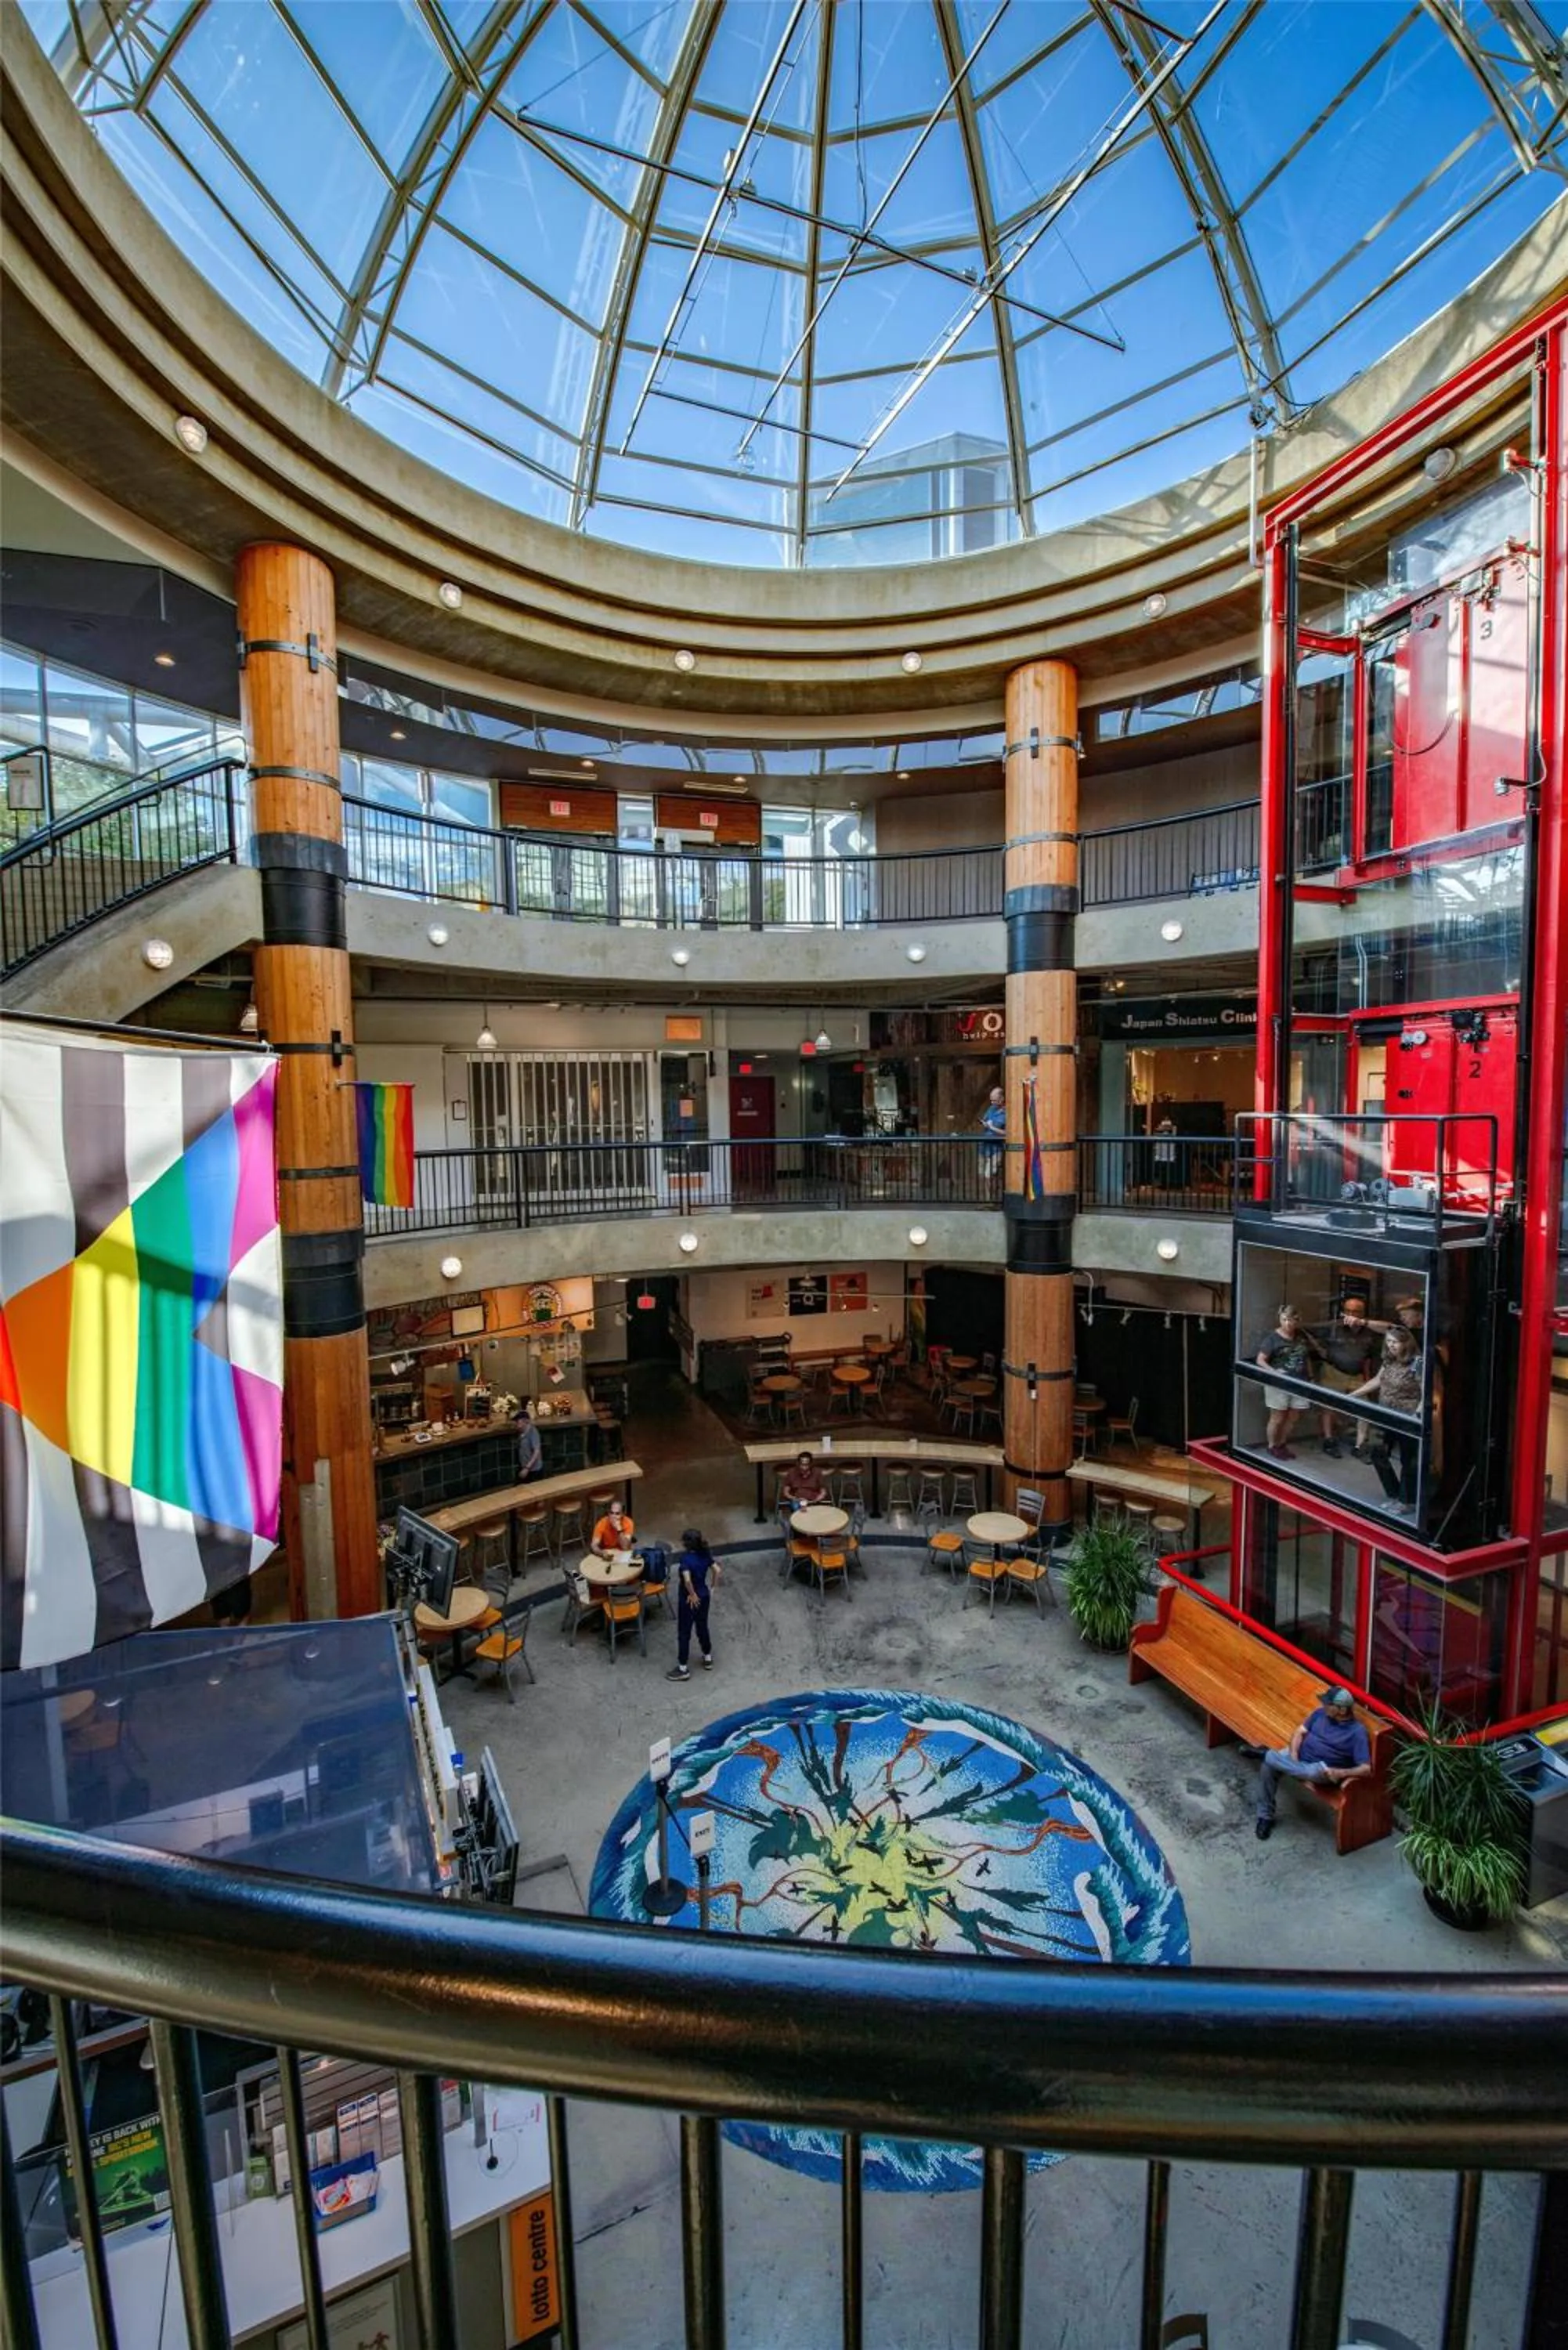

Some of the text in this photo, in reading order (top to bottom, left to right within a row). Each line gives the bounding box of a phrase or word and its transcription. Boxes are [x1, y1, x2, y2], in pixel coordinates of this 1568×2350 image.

[1480, 620, 1492, 640] 3
[1121, 1009, 1257, 1030] Japan Shiatsu Clini
[1469, 1061, 1481, 1078] 2
[103, 2134, 112, 2144] IS
[114, 2124, 138, 2139] BACK
[528, 2210, 551, 2323] lotto centre
